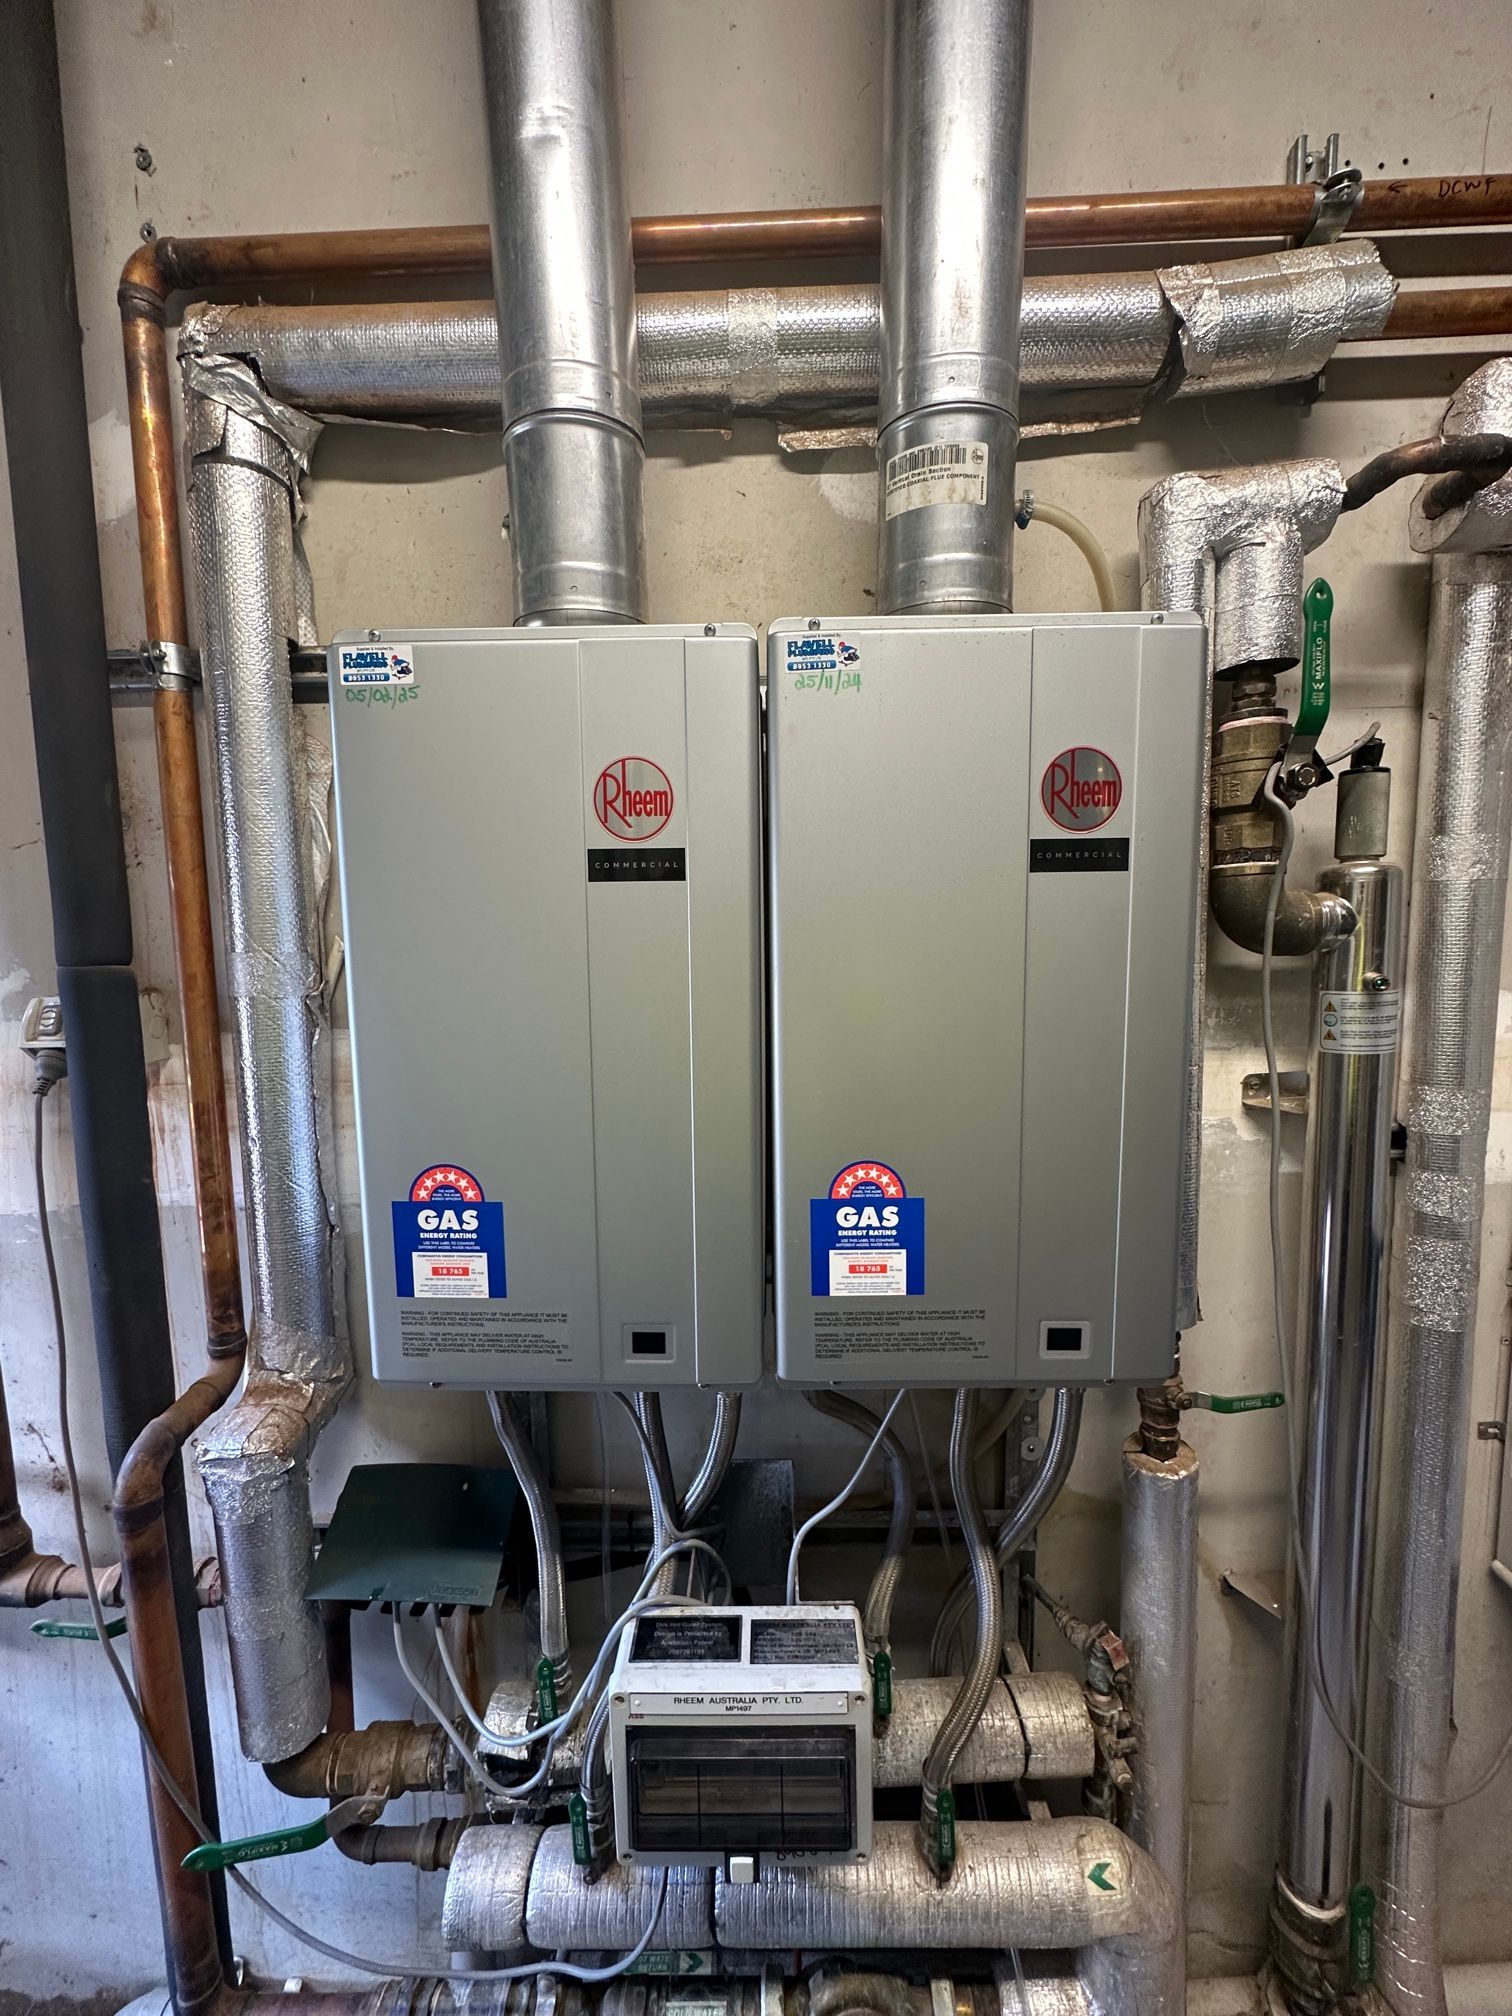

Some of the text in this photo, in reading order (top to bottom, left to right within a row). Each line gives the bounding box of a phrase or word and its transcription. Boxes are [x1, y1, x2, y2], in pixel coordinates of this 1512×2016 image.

[892, 476, 909, 487] Vertical
[907, 477, 929, 487] COAXIAL
[788, 639, 835, 650] FLAVELL
[343, 652, 388, 662] FLAVELL
[1050, 749, 1116, 819] Rheem
[602, 759, 671, 828] Rheem
[417, 1210, 479, 1230] GAS
[836, 1206, 899, 1227] GAS
